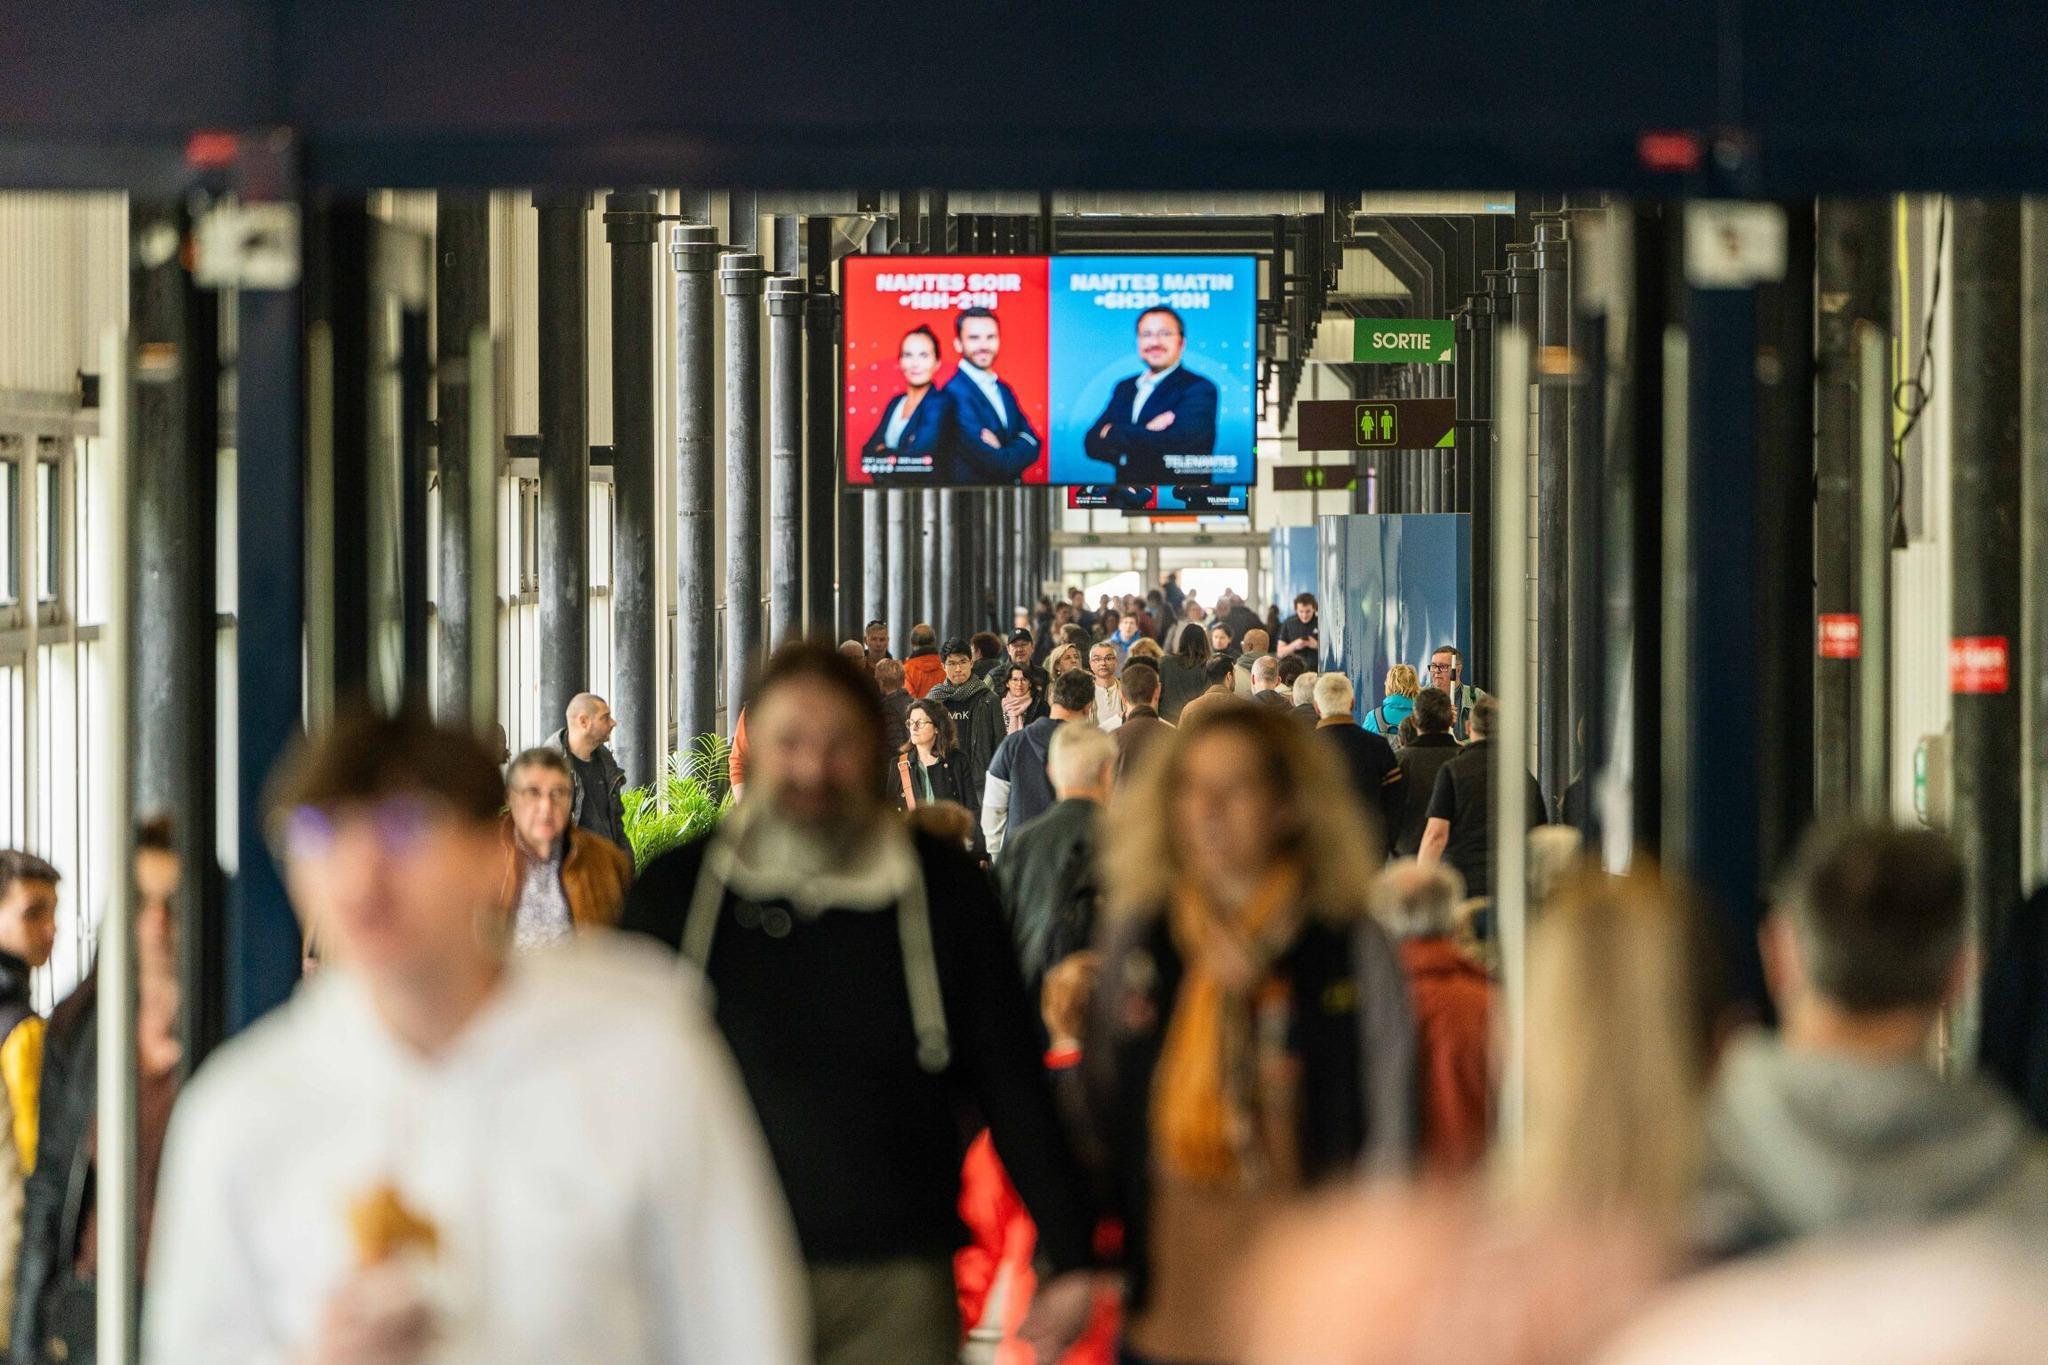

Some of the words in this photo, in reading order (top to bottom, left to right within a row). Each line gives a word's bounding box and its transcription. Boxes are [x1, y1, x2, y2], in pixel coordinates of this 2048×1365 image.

[876, 273, 966, 292] NANTES
[967, 273, 1021, 292] SOIR
[1070, 273, 1159, 291] NANTES
[1162, 273, 1234, 291] MATIN
[1372, 332, 1431, 350] SORTIE
